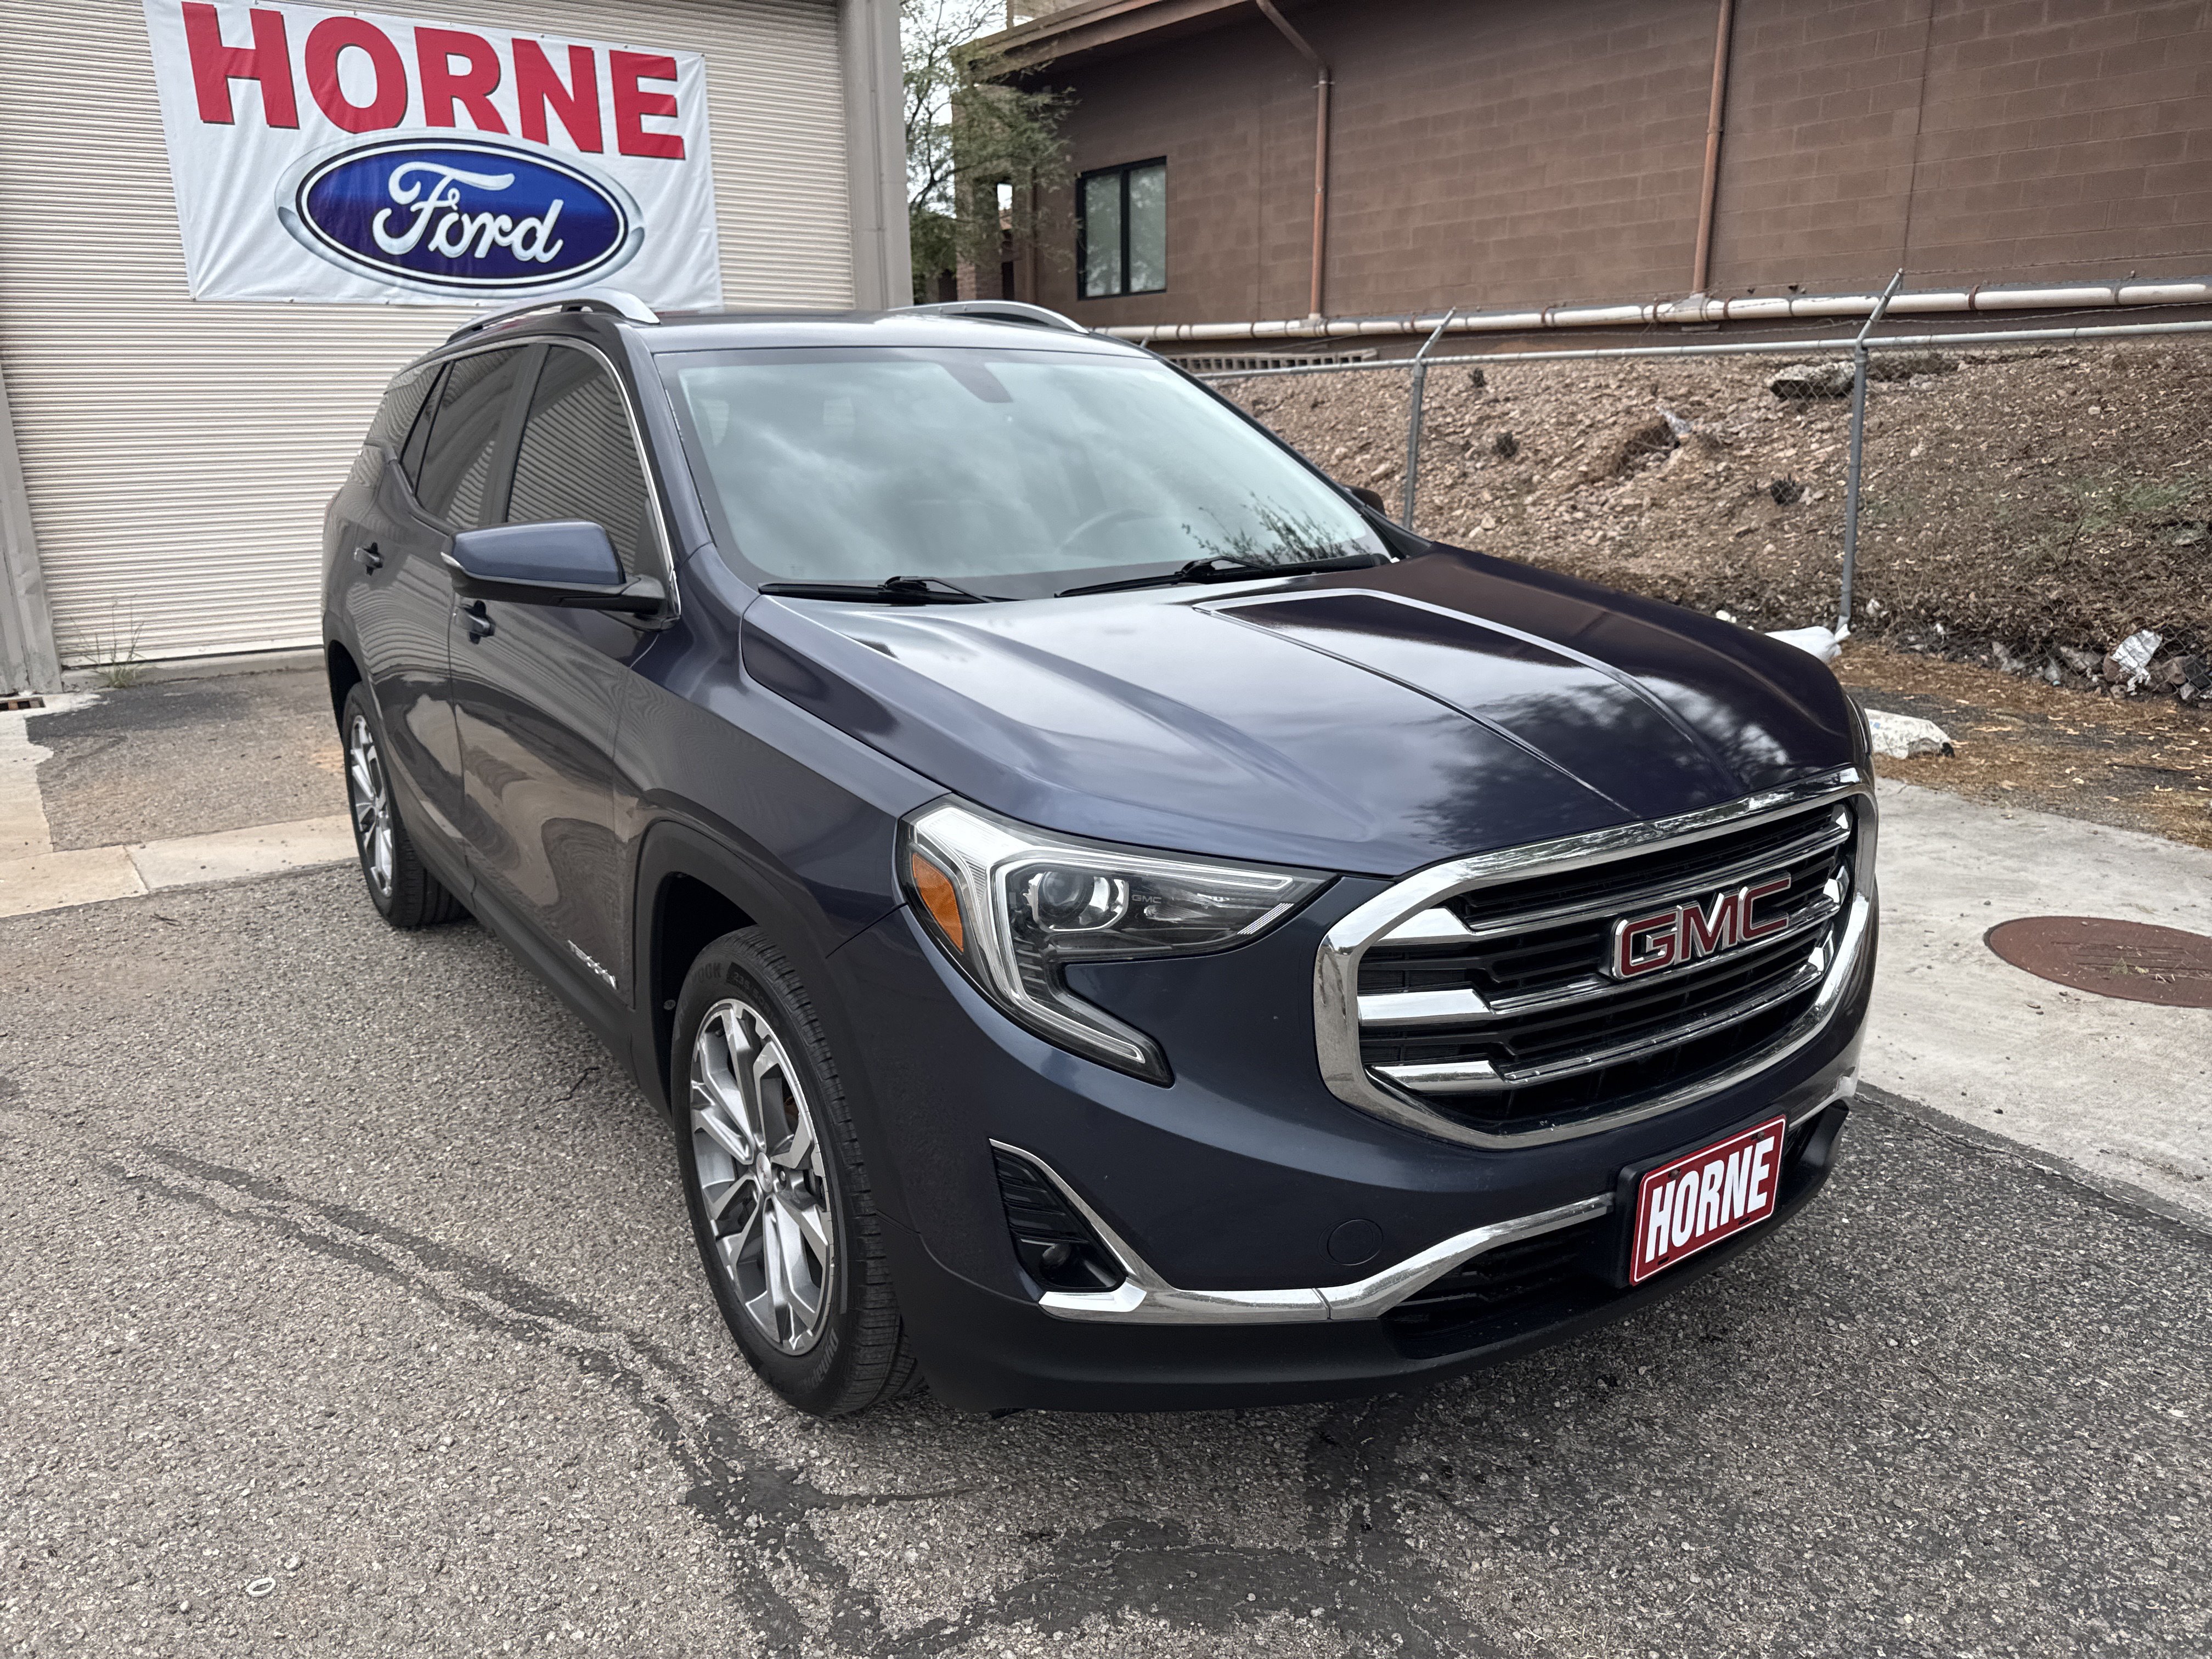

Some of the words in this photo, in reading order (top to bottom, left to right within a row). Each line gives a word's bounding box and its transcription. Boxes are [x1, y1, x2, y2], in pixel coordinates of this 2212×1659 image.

[182, 2, 685, 160] HORNE
[373, 161, 564, 263] Ford
[1131, 894, 1162, 904] GMC
[1613, 876, 1791, 979] GMC
[1646, 1136, 1775, 1263] HORNE
